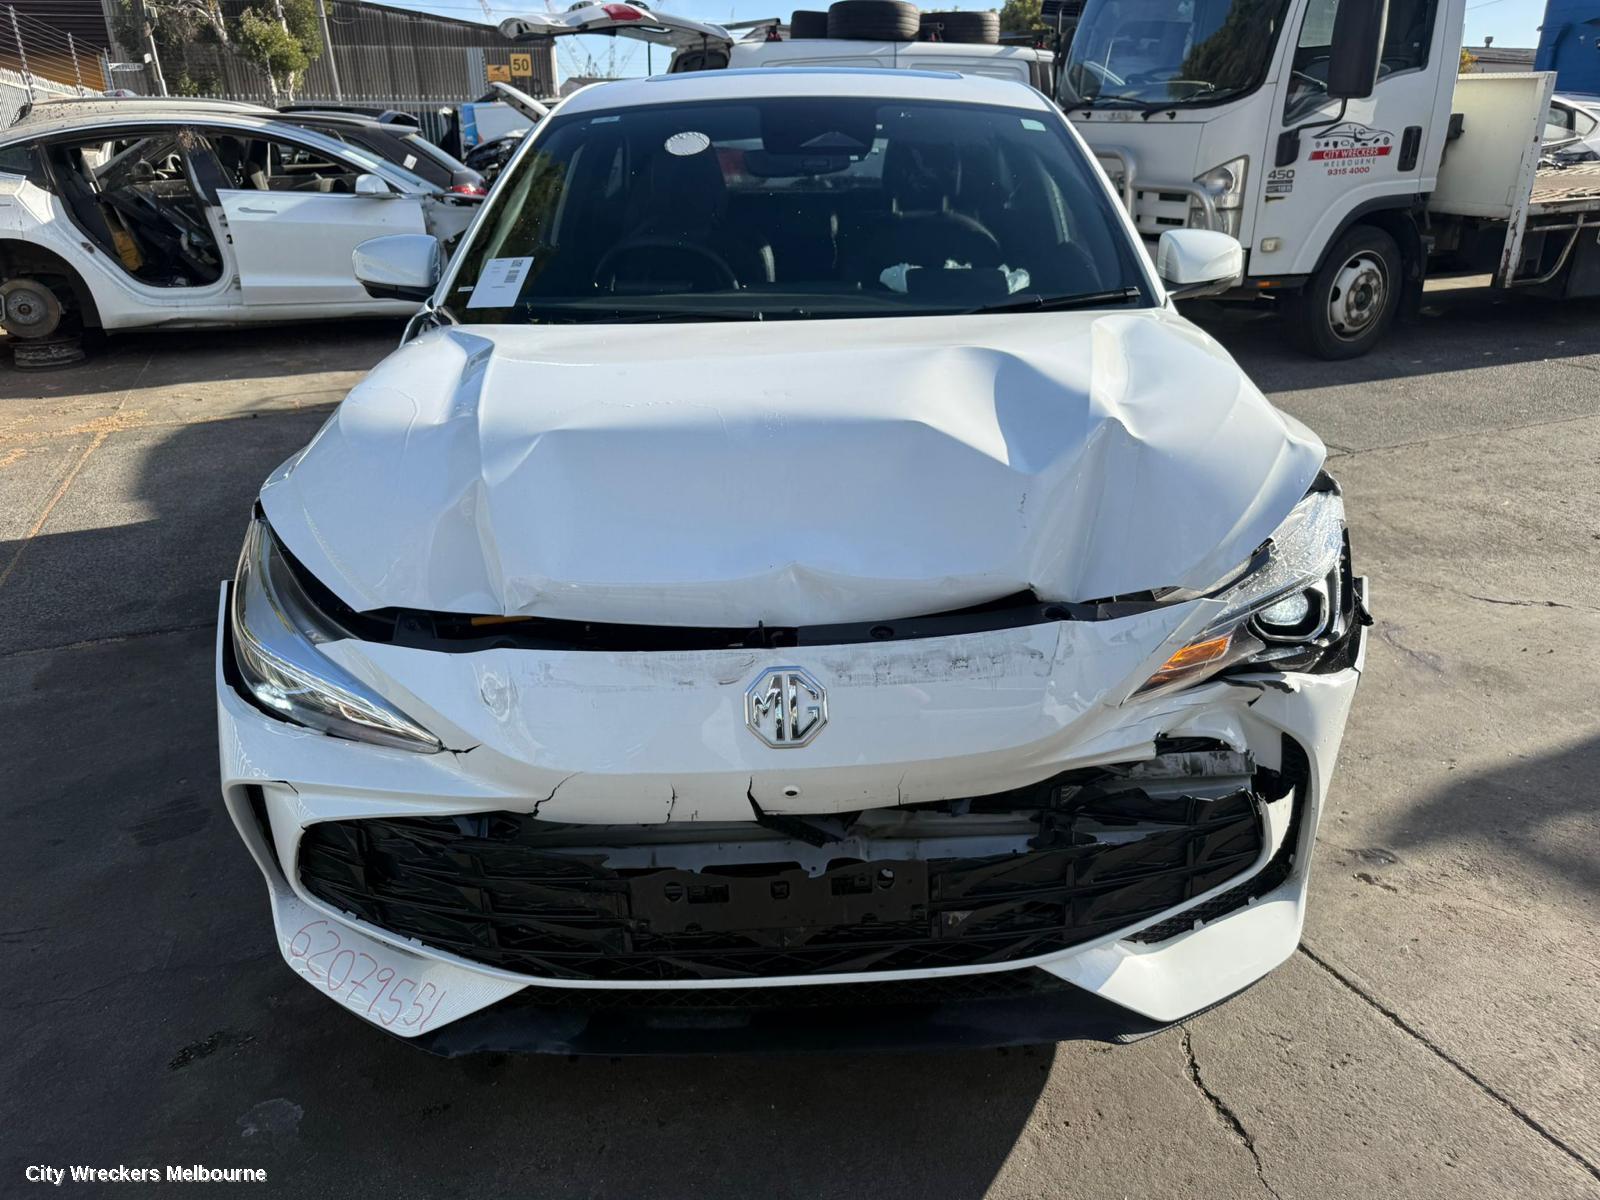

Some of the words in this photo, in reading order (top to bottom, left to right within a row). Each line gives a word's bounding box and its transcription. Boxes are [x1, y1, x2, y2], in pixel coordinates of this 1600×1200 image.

[513, 59, 529, 71] 50
[1323, 150, 1340, 159] CITY
[1341, 148, 1379, 158] WRECKERS
[1323, 158, 1377, 167] MELBOURNE
[1268, 169, 1295, 180] 450
[1327, 168, 1347, 176] 9315
[1349, 166, 1370, 174] 4000
[752, 673, 820, 741] MG
